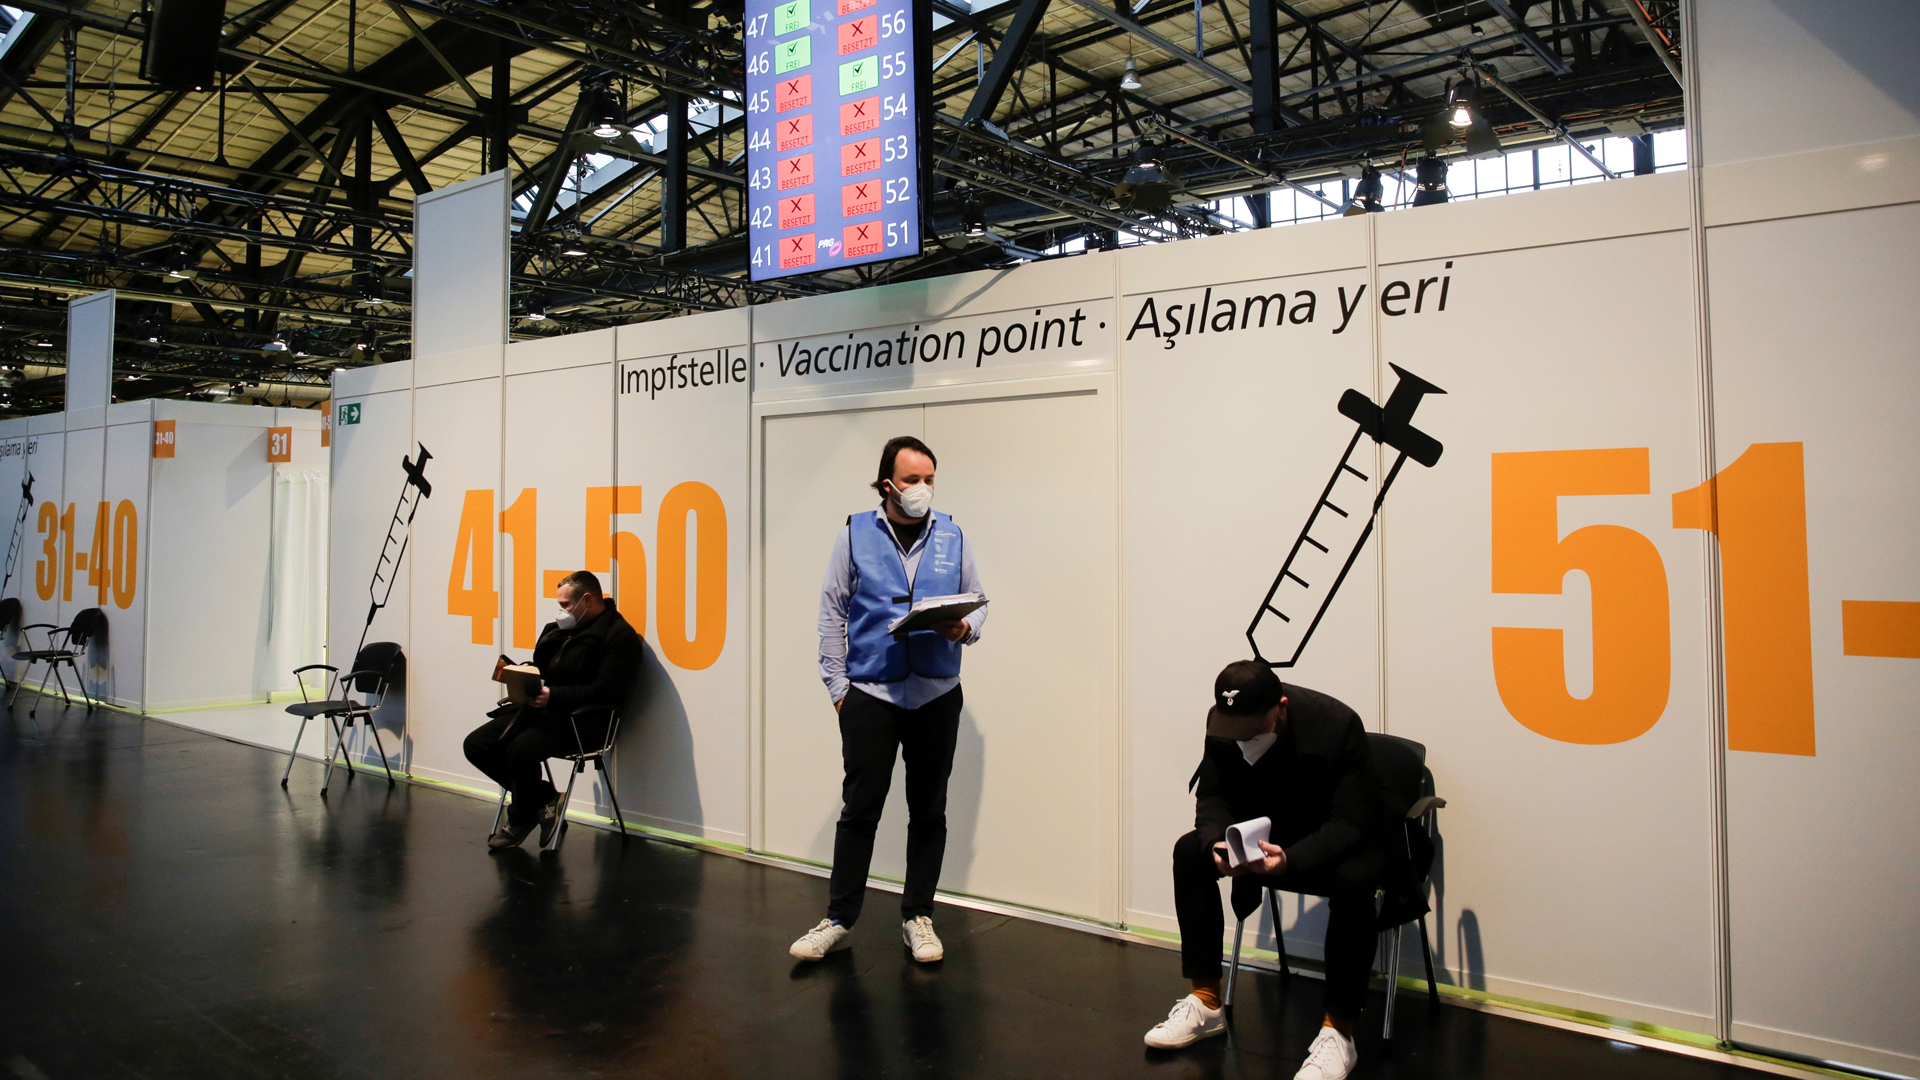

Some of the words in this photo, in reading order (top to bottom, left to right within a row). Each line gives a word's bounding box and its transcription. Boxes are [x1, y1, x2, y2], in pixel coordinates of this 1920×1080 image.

[746, 14, 768, 38] 47
[785, 21, 800, 32] FREI
[842, 37, 874, 54] BESETZT
[881, 10, 906, 38] 56
[747, 51, 770, 76] 46
[786, 59, 800, 70] FREI
[851, 80, 867, 92] FREI
[882, 51, 907, 79] 55
[748, 90, 770, 114] 45
[779, 96, 808, 111] BESETZT
[844, 119, 875, 135] BESETZT
[883, 93, 908, 121] 54
[748, 128, 771, 152] 44
[780, 135, 808, 150] BESETZT
[845, 160, 877, 175] BESETZT
[884, 135, 908, 162] 53
[750, 167, 771, 190] 43
[781, 175, 810, 190] BESETZT
[846, 201, 878, 216] BESETZT
[885, 177, 910, 204] 52
[750, 205, 773, 229] 42
[782, 215, 811, 229] BESETZT
[818, 238, 835, 249] PRG
[848, 243, 879, 257] BESETZT
[887, 220, 909, 247] 51
[751, 244, 772, 268] 41
[783, 255, 812, 268] BESETZT
[619, 348, 747, 400] Impfstelle
[776, 324, 965, 379] Vaccination
[975, 307, 1087, 368] point
[1126, 287, 1317, 350] Aşılama
[155, 431, 174, 446] 31-40
[271, 432, 288, 456] 31
[35, 498, 138, 610] 31-40
[447, 480, 728, 671] 41-50
